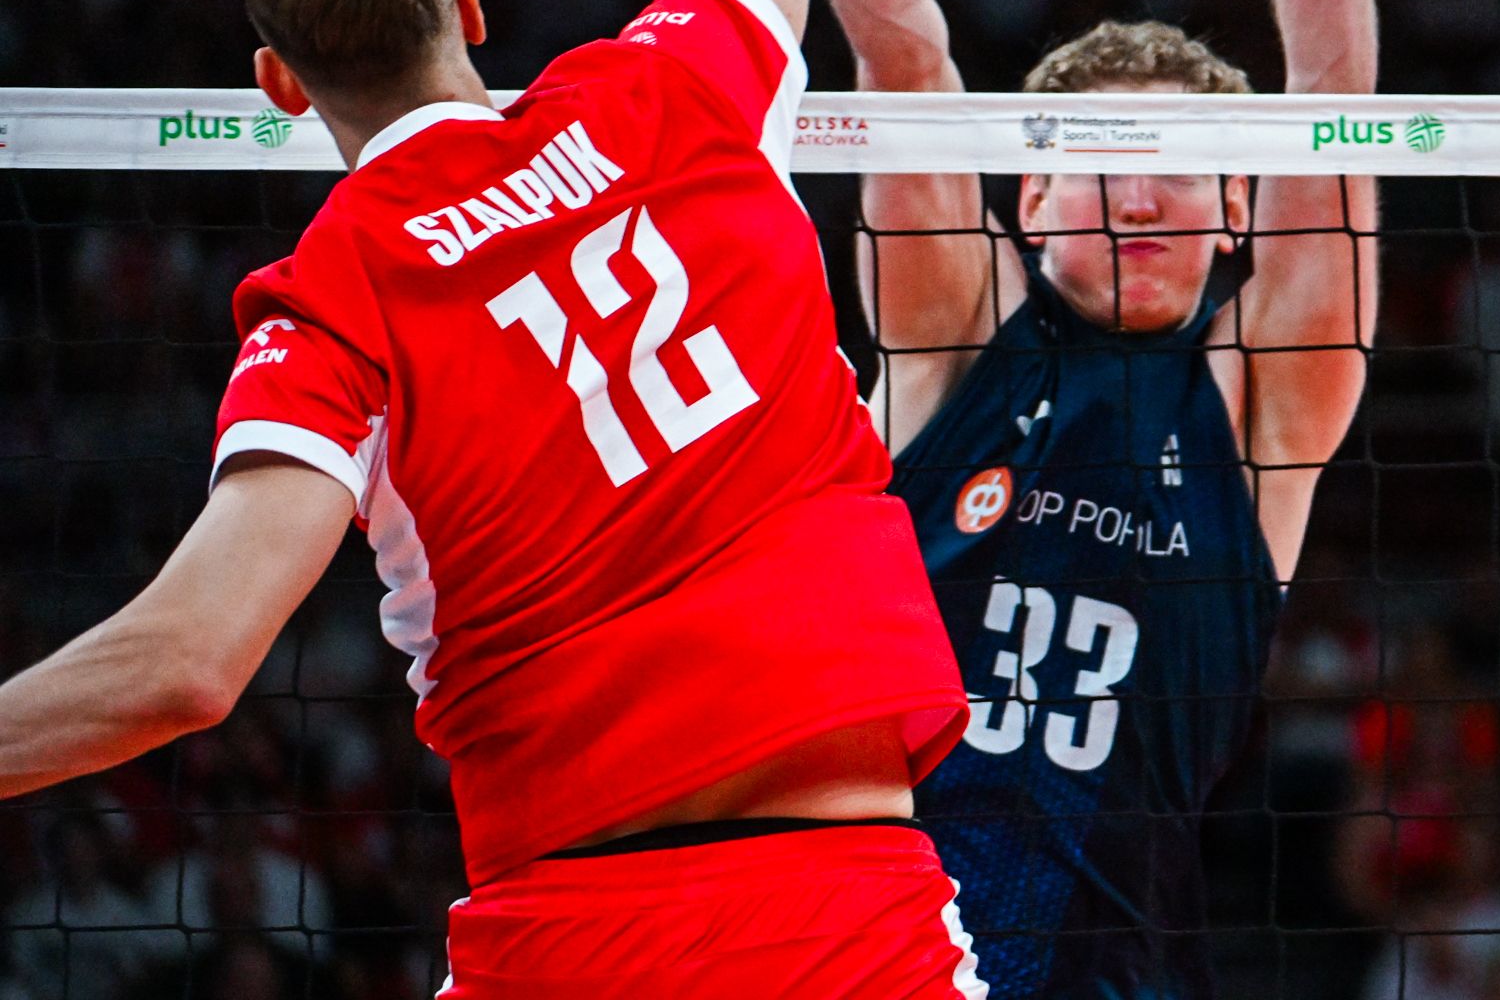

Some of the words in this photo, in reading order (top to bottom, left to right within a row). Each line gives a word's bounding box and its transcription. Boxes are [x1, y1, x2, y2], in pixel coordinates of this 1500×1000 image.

[158, 109, 242, 147] plus
[794, 131, 869, 146] ATKÓWKA
[796, 116, 869, 131] OLSKA
[1312, 114, 1394, 151] plus
[403, 119, 626, 267] SZALPUK
[484, 203, 761, 489] 12
[1016, 488, 1065, 526] OP
[961, 574, 1139, 772] 33
